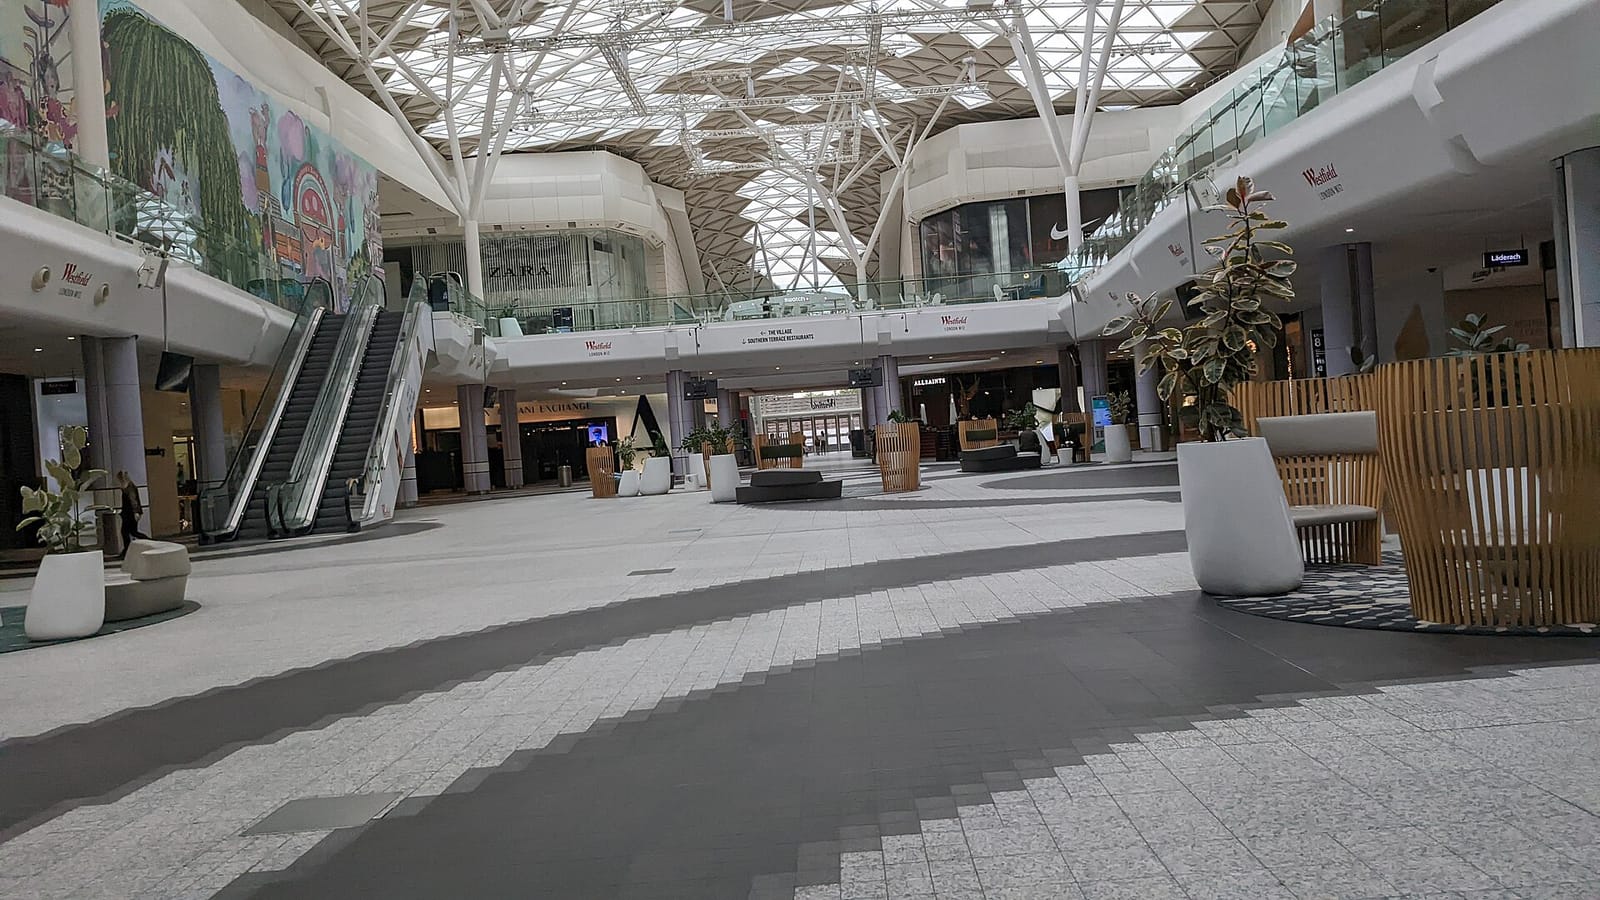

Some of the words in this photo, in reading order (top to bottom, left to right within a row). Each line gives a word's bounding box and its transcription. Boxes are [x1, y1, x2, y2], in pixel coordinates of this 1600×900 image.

[1302, 162, 1338, 187] Westfield
[61, 263, 92, 286] Westfield
[489, 263, 552, 278] ZARA
[941, 315, 968, 325] Westfield
[786, 333, 814, 341] RESTAURANTS
[584, 340, 612, 351] Westfield
[913, 377, 946, 387] ALLSAINTS
[540, 402, 593, 414] EXCHANGE
